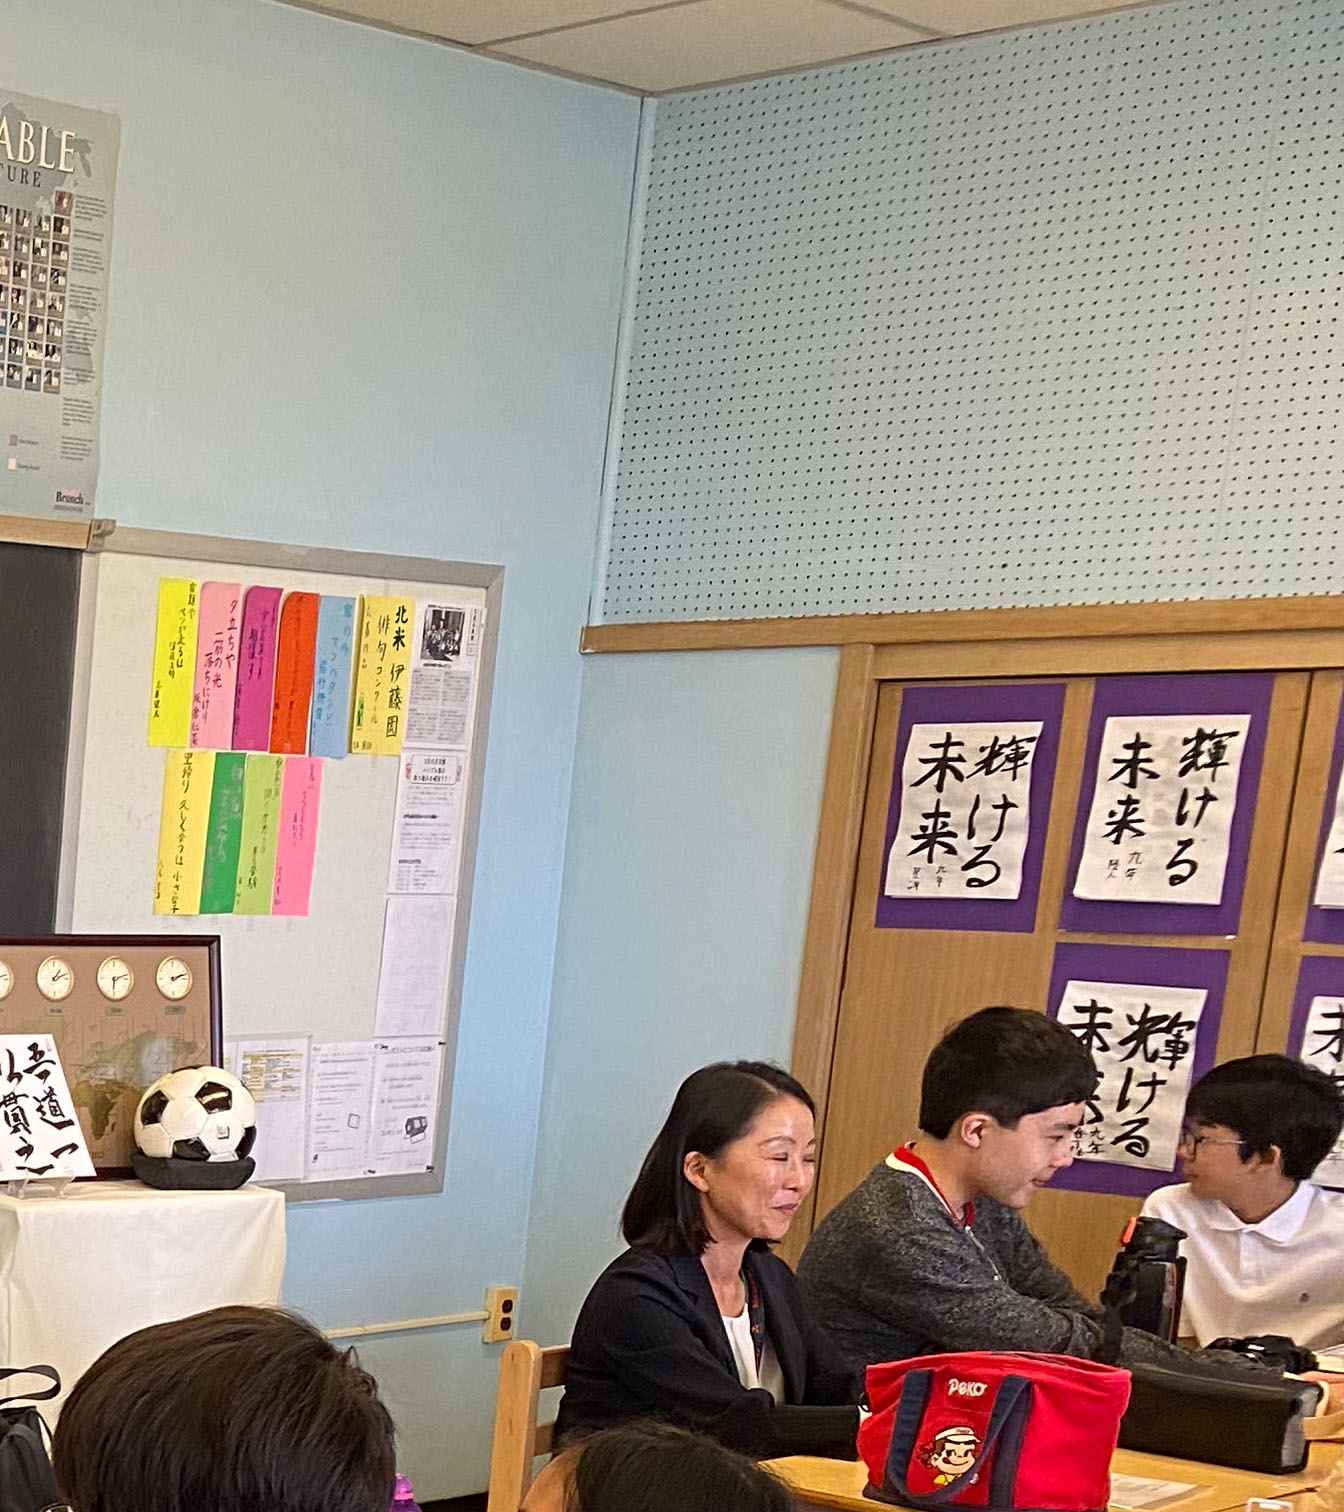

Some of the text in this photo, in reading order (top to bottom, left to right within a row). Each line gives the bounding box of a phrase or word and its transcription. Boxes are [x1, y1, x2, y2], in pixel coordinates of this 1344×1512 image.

[906, 731, 968, 864] 未来
[961, 735, 1037, 889] 輝ける
[1102, 731, 1161, 845] 未来
[1165, 727, 1240, 887] 輝ける
[1110, 1003, 1196, 1158] 輝ける
